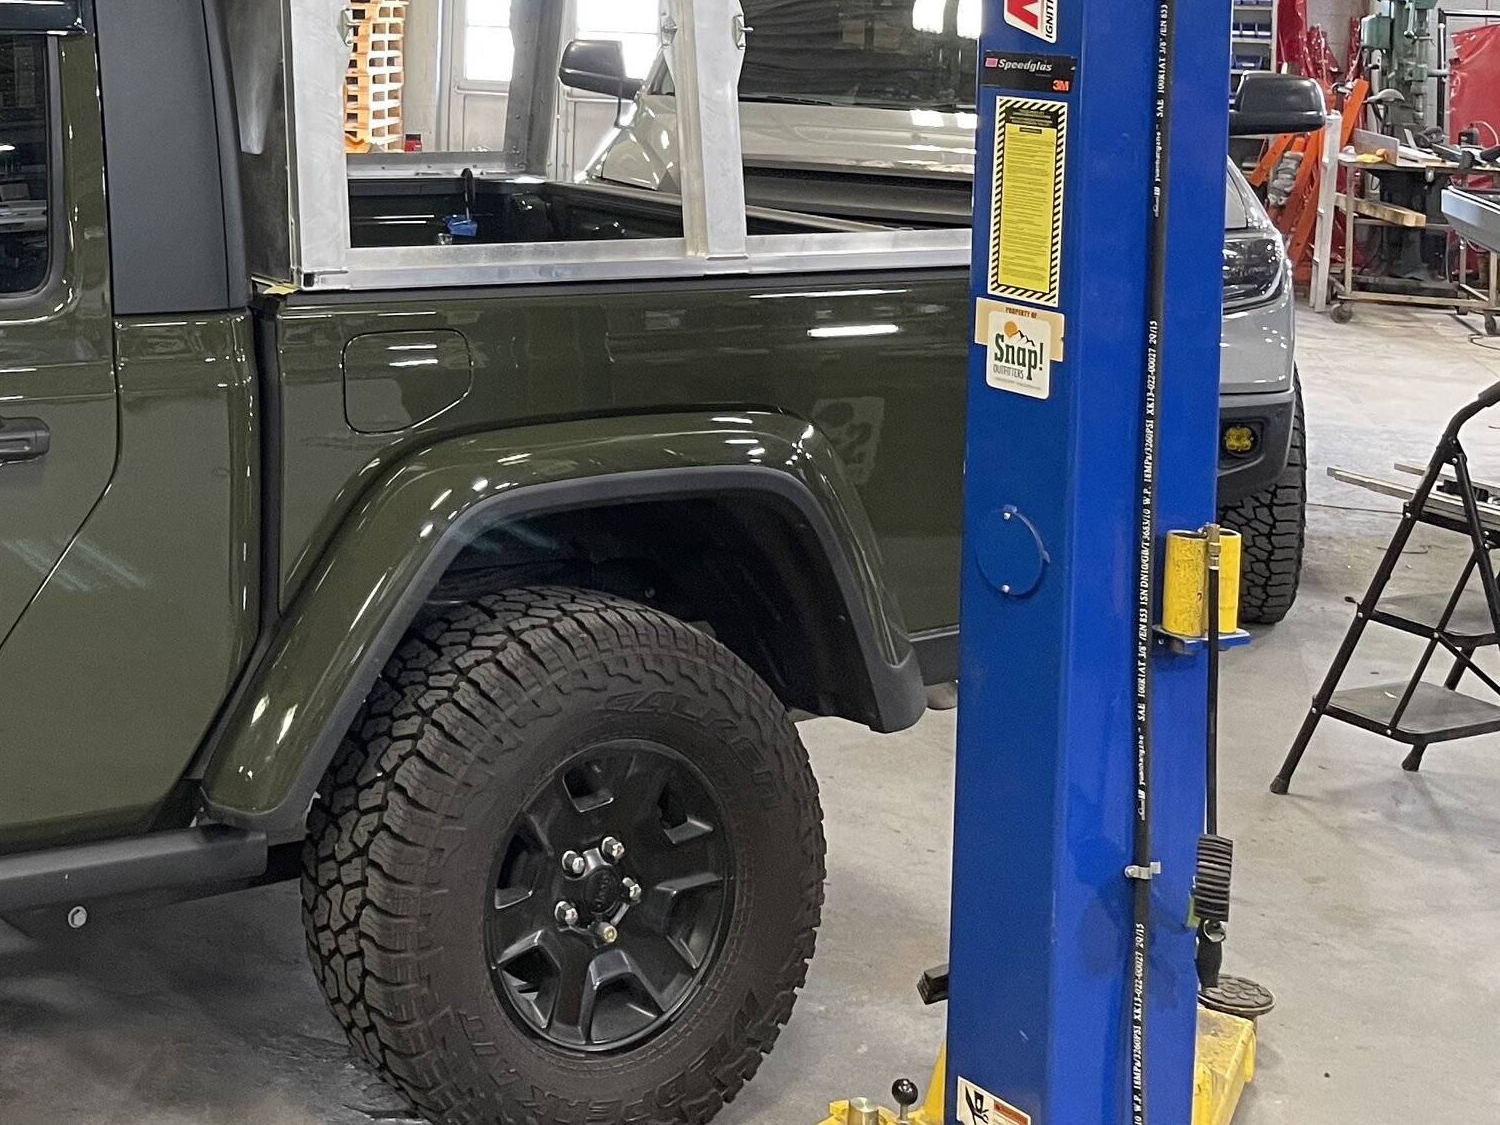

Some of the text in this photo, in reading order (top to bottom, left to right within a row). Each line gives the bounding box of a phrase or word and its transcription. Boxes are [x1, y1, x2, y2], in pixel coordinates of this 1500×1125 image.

[998, 58, 1053, 72] Speedglas
[1052, 80, 1070, 92] 3M
[994, 332, 1044, 381] Snap!
